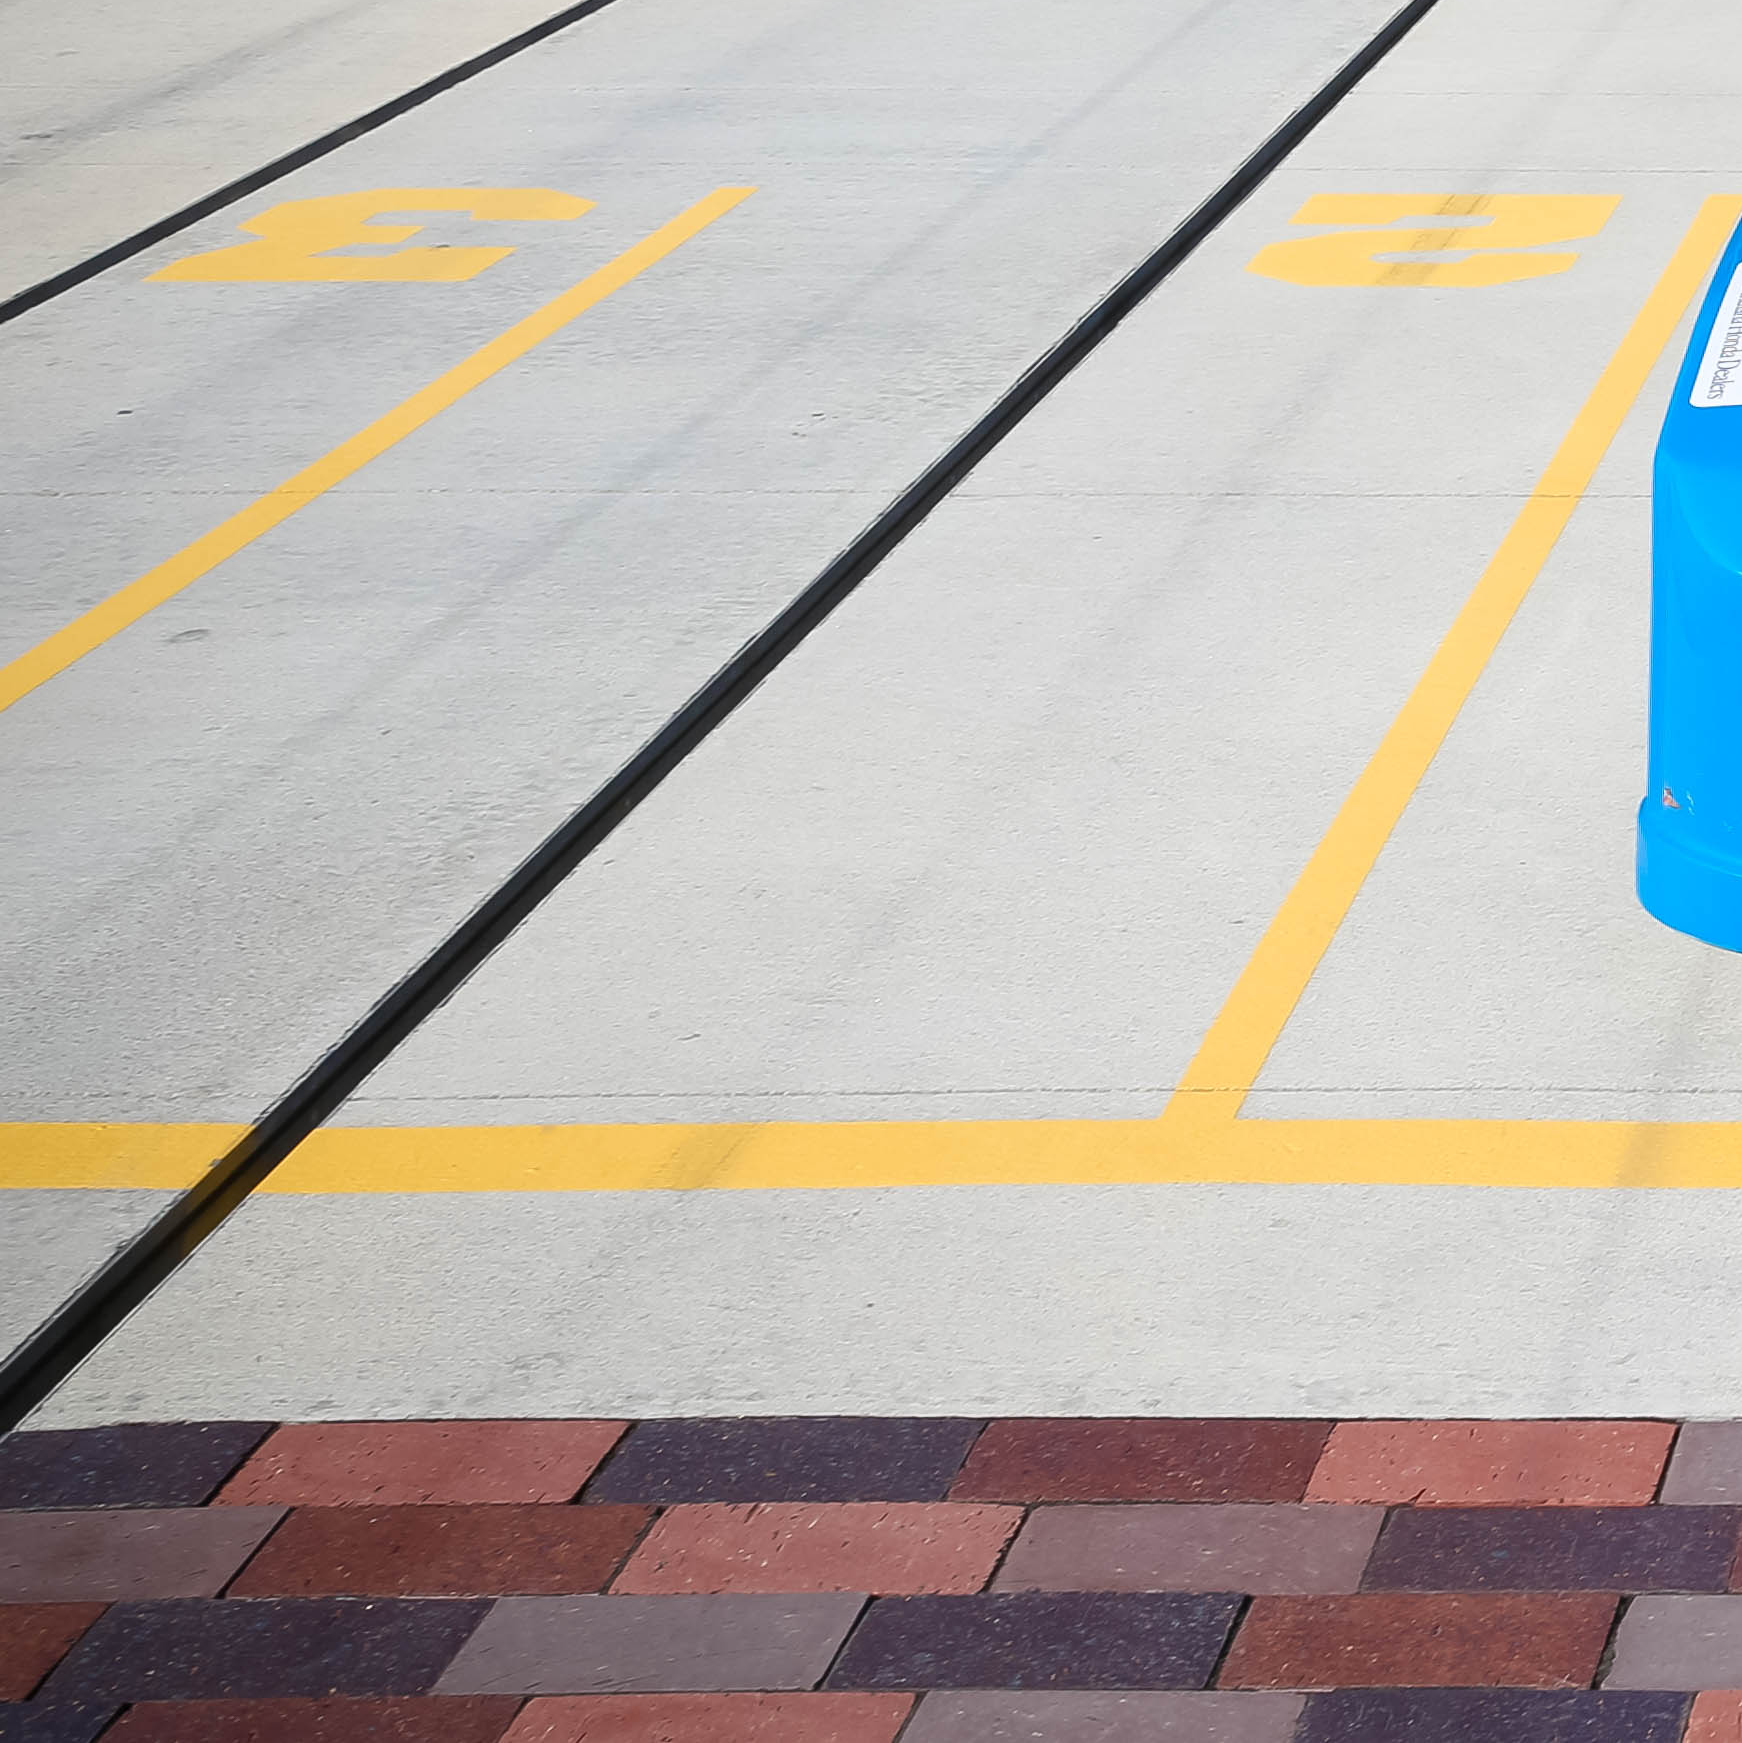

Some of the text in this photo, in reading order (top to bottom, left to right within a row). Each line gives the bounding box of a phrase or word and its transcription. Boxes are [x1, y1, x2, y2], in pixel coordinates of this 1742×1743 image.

[141, 188, 597, 281] 3
[1243, 194, 1624, 288] 2
[1706, 358, 1742, 400] Dealers
